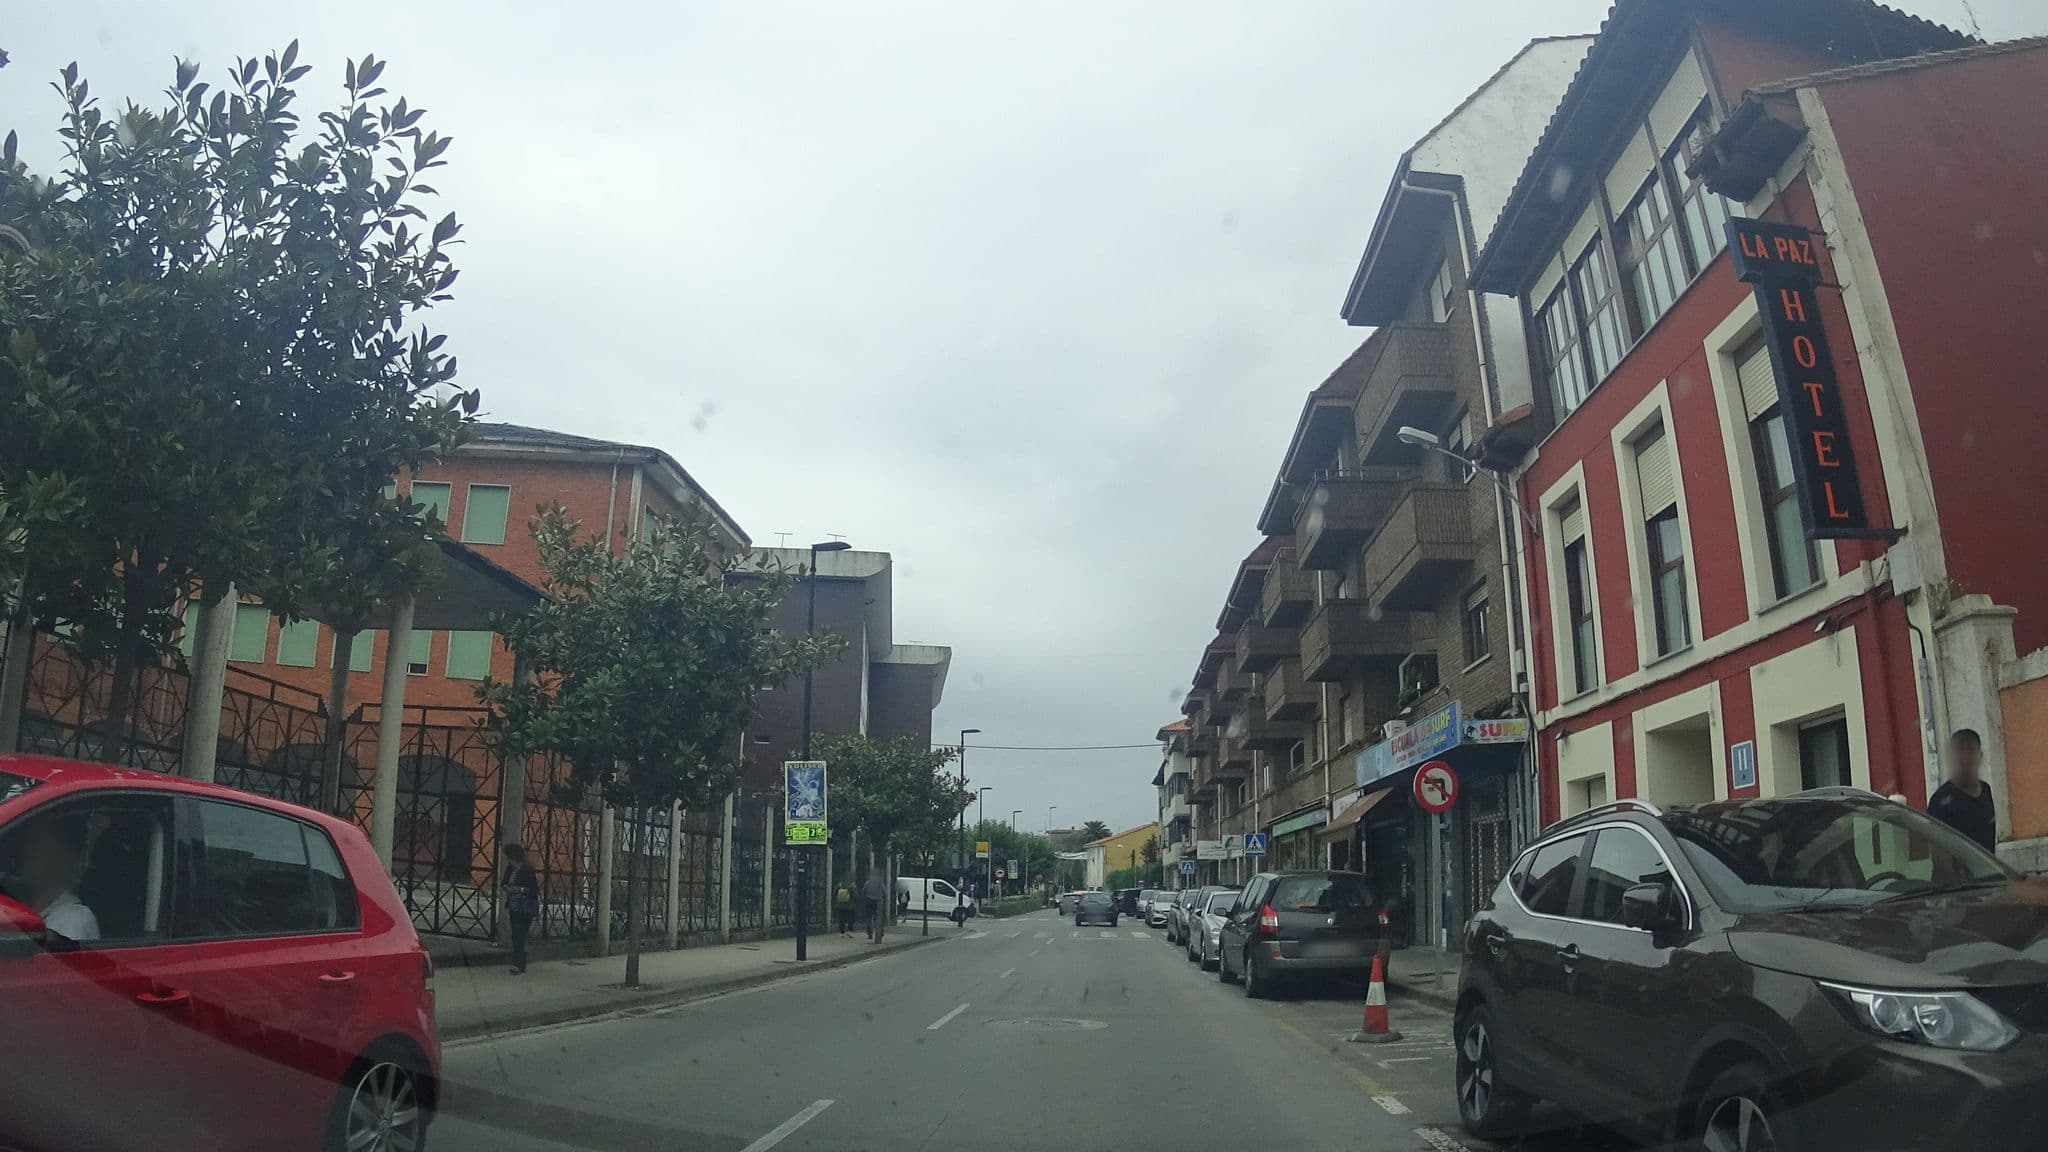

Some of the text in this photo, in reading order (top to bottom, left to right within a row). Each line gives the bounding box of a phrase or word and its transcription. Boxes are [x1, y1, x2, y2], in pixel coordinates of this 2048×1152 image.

[1738, 230, 1815, 265] LA PAZ
[1779, 288, 1849, 519] HOTEL
[1431, 709, 1451, 734] SURF
